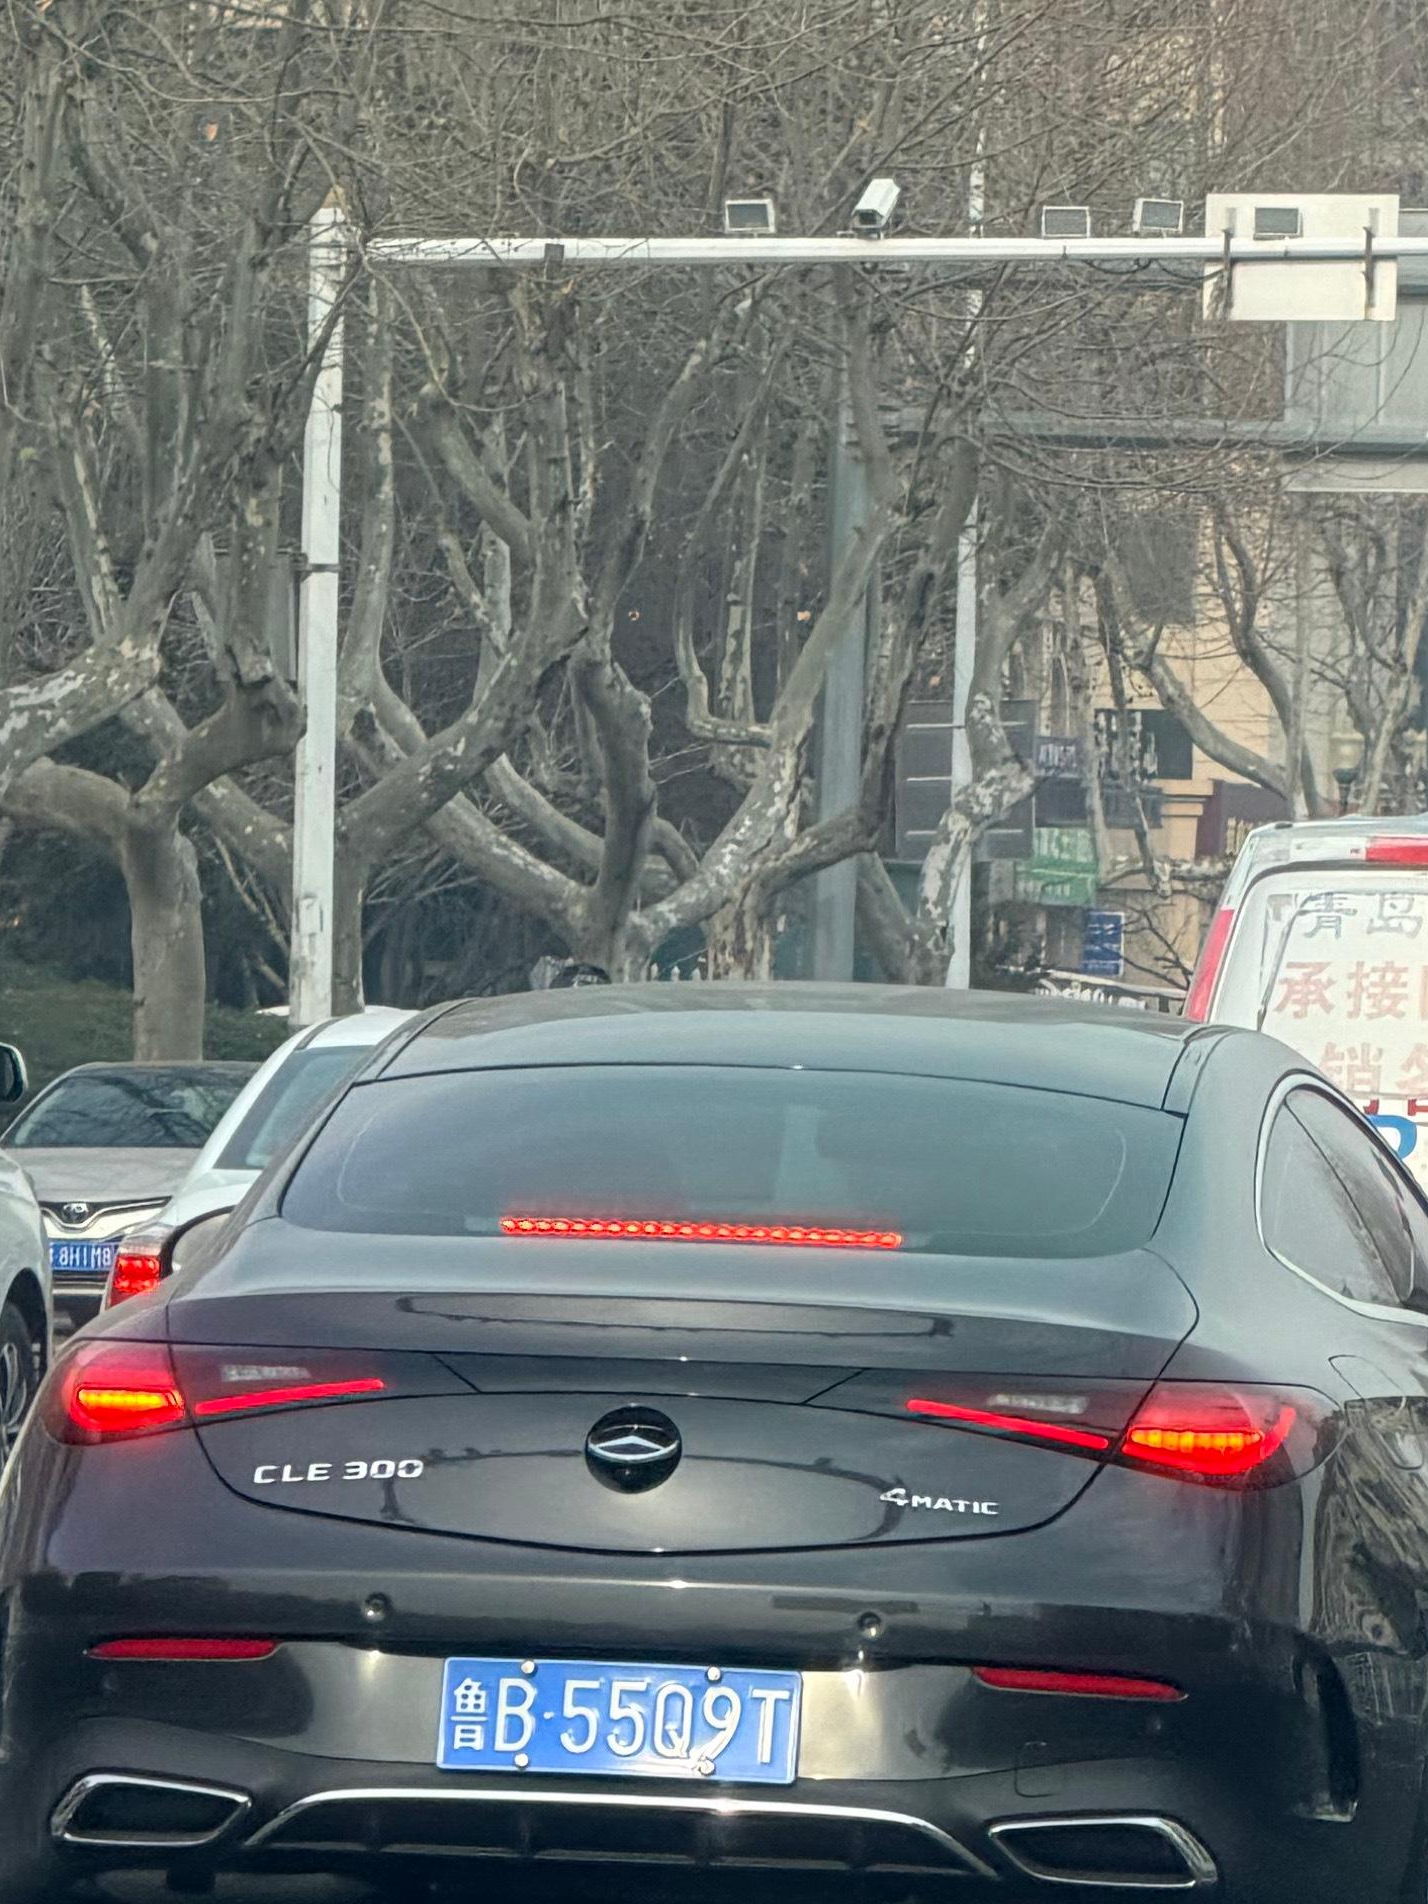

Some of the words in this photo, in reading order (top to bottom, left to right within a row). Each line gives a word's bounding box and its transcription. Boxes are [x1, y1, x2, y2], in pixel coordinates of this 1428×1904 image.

[253, 1463, 333, 1484] CLE
[342, 1459, 425, 1480] 300
[879, 1487, 1000, 1515] 4MATIC
